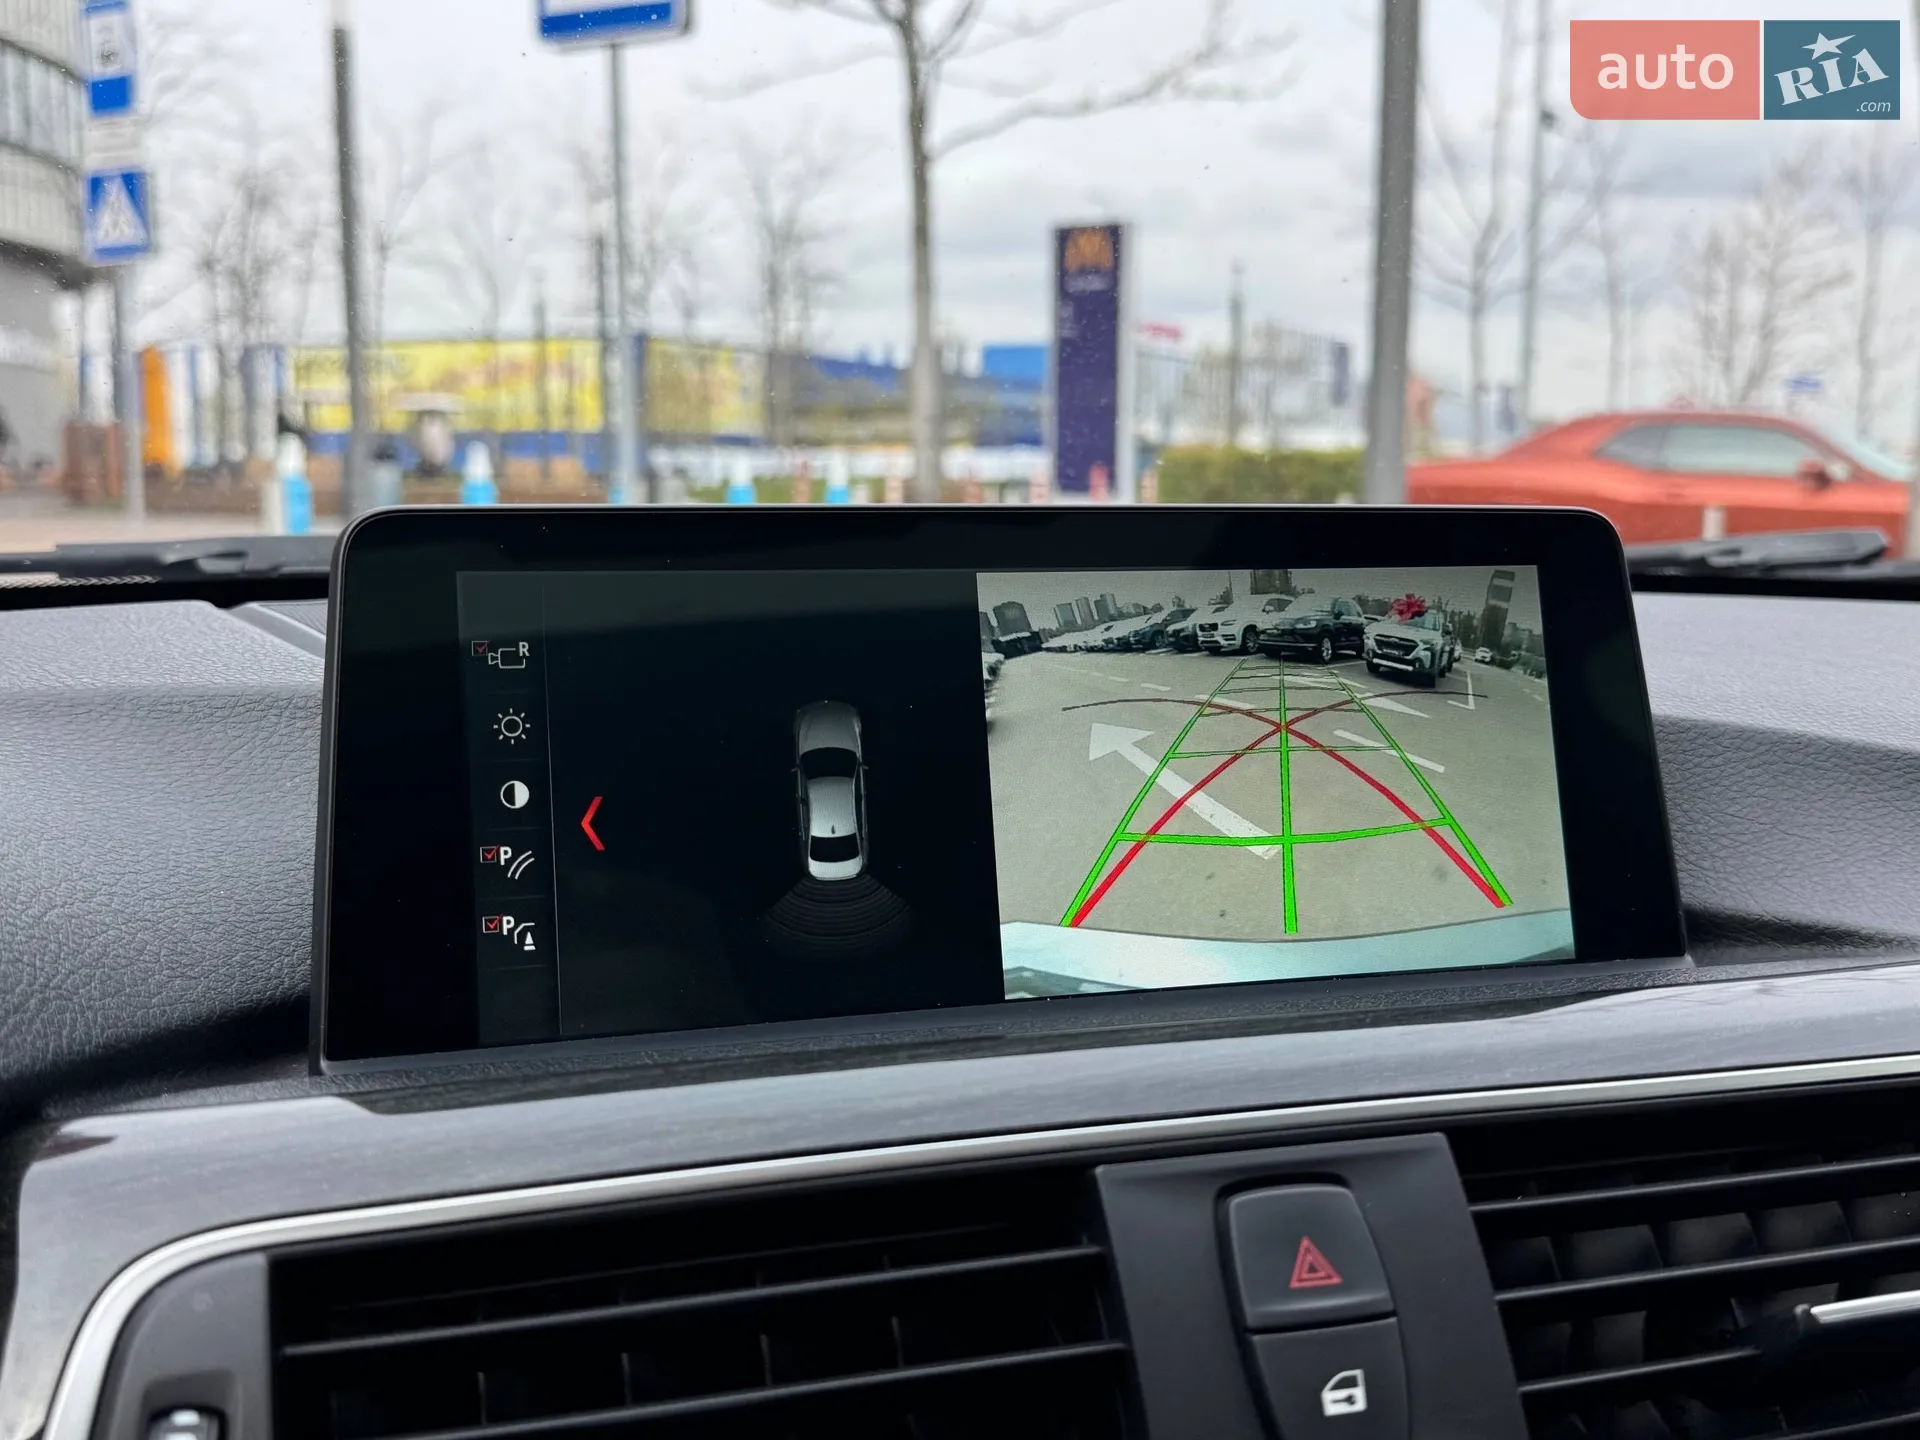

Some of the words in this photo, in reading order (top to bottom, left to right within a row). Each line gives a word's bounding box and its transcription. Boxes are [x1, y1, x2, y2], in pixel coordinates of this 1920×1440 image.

[518, 641, 530, 657] R
[500, 846, 512, 866] P
[502, 916, 515, 936] P
